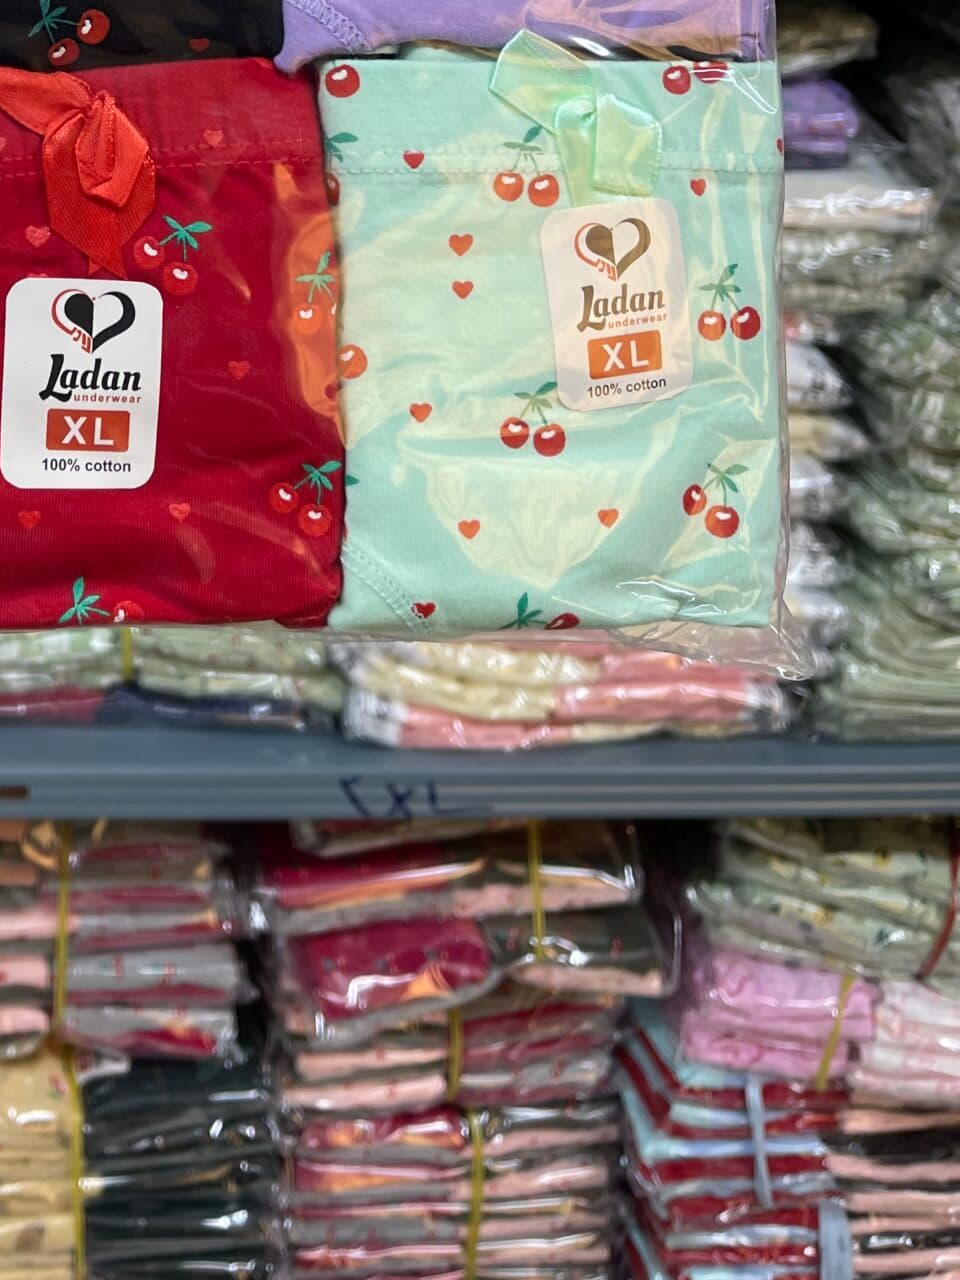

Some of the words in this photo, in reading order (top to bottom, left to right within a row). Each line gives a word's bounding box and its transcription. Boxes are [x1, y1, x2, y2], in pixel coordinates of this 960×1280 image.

[577, 283, 665, 333] Ladan
[608, 314, 667, 329] underwear
[602, 340, 649, 372] XL
[39, 354, 142, 403] Ladan
[587, 383, 622, 398] 100%
[626, 377, 667, 393] cotton
[73, 393, 142, 403] underwear
[61, 416, 114, 446] XL
[42, 458, 81, 472] 100%
[85, 459, 131, 472] cotton
